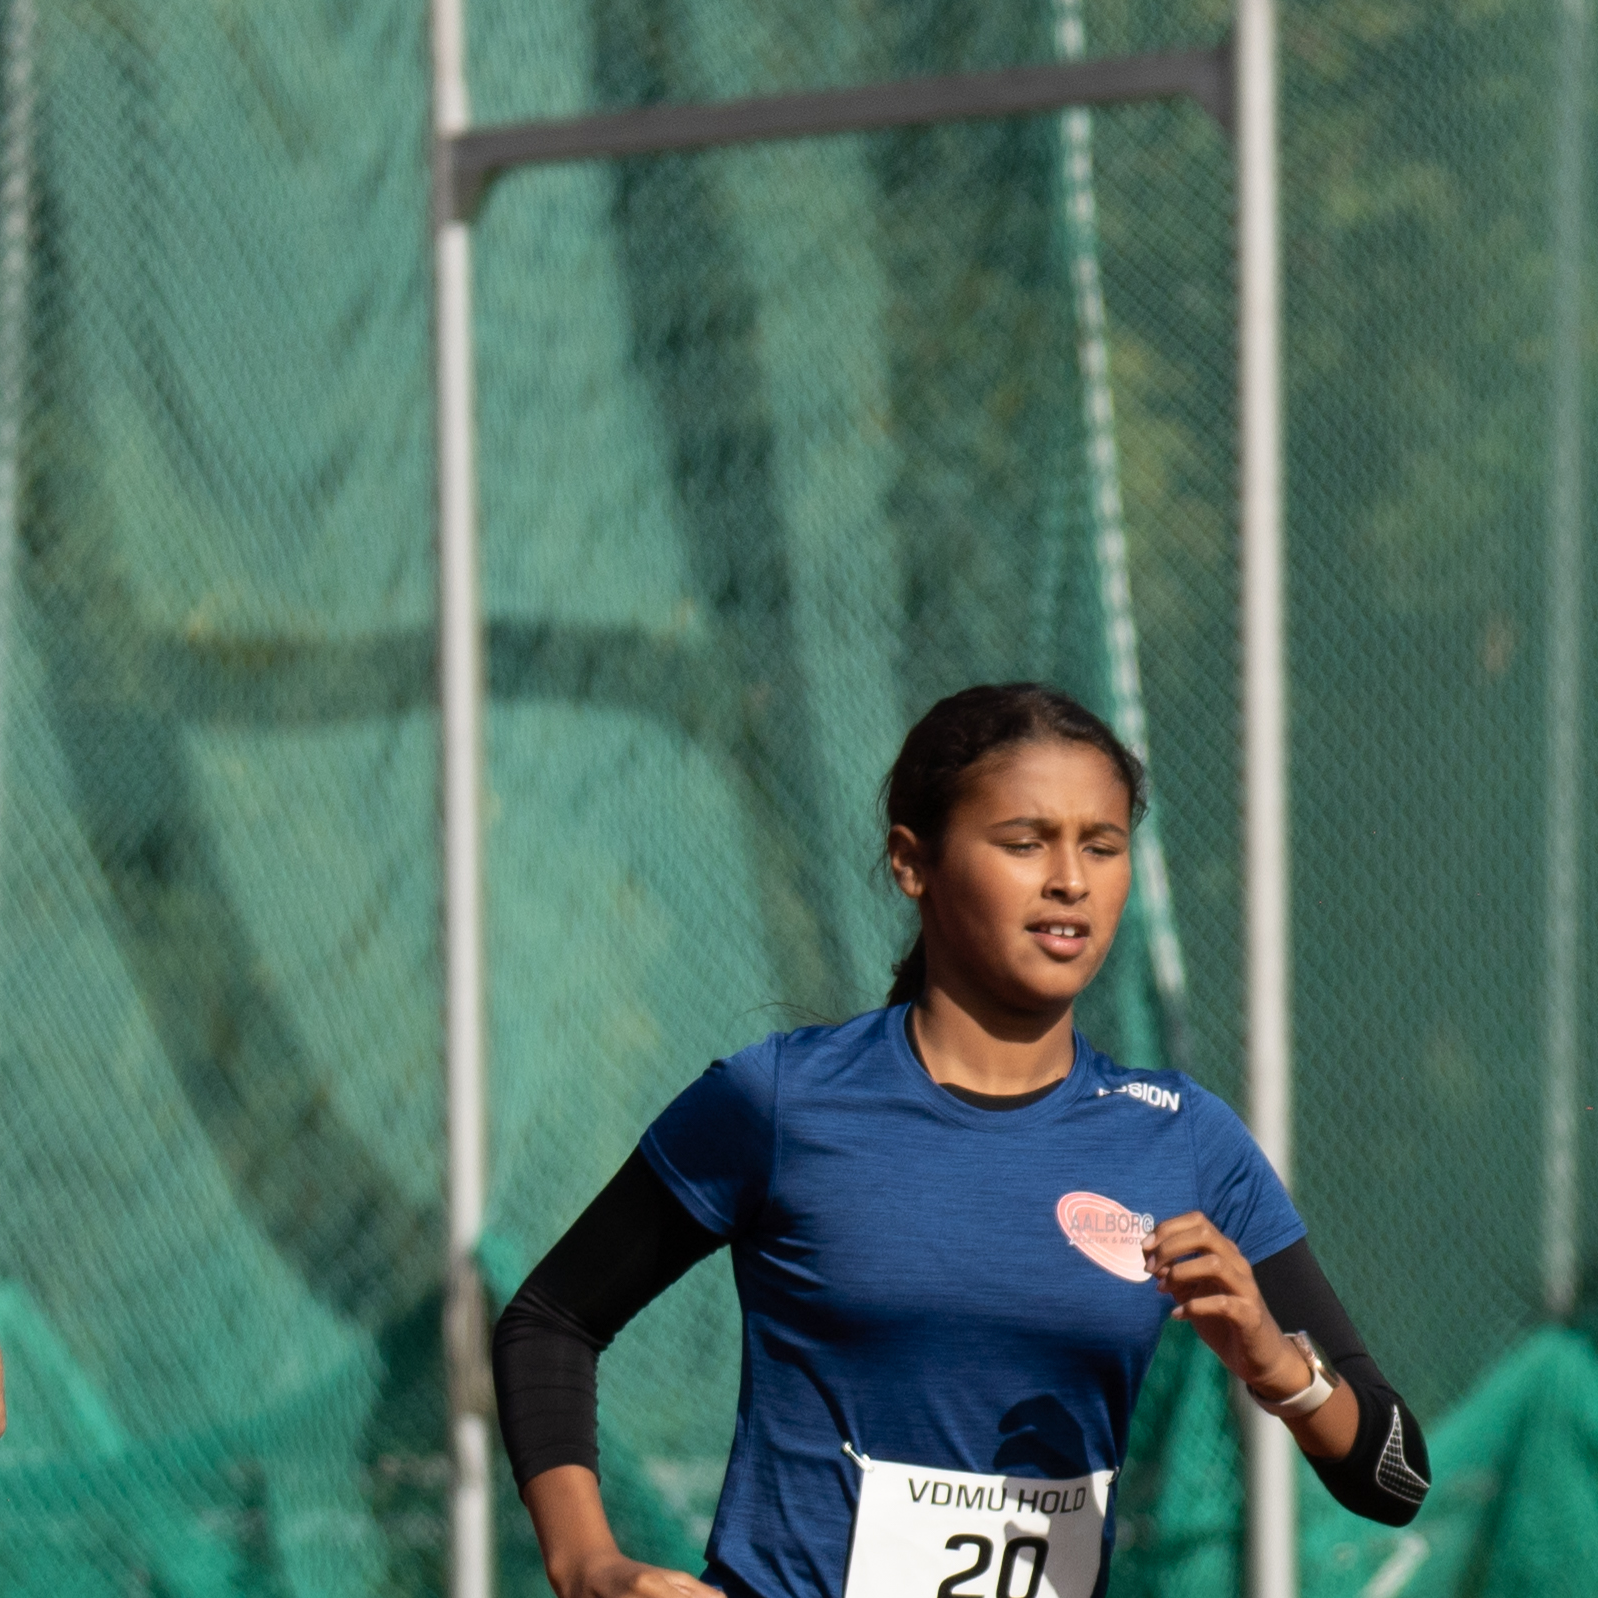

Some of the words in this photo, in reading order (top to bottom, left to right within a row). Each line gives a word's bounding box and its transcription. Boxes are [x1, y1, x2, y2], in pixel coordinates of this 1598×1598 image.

[1098, 1082, 1180, 1112] SION
[1069, 1212, 1153, 1235] AALBORG
[908, 1478, 1007, 1512] VDMU
[1017, 1486, 1087, 1514] HOLD
